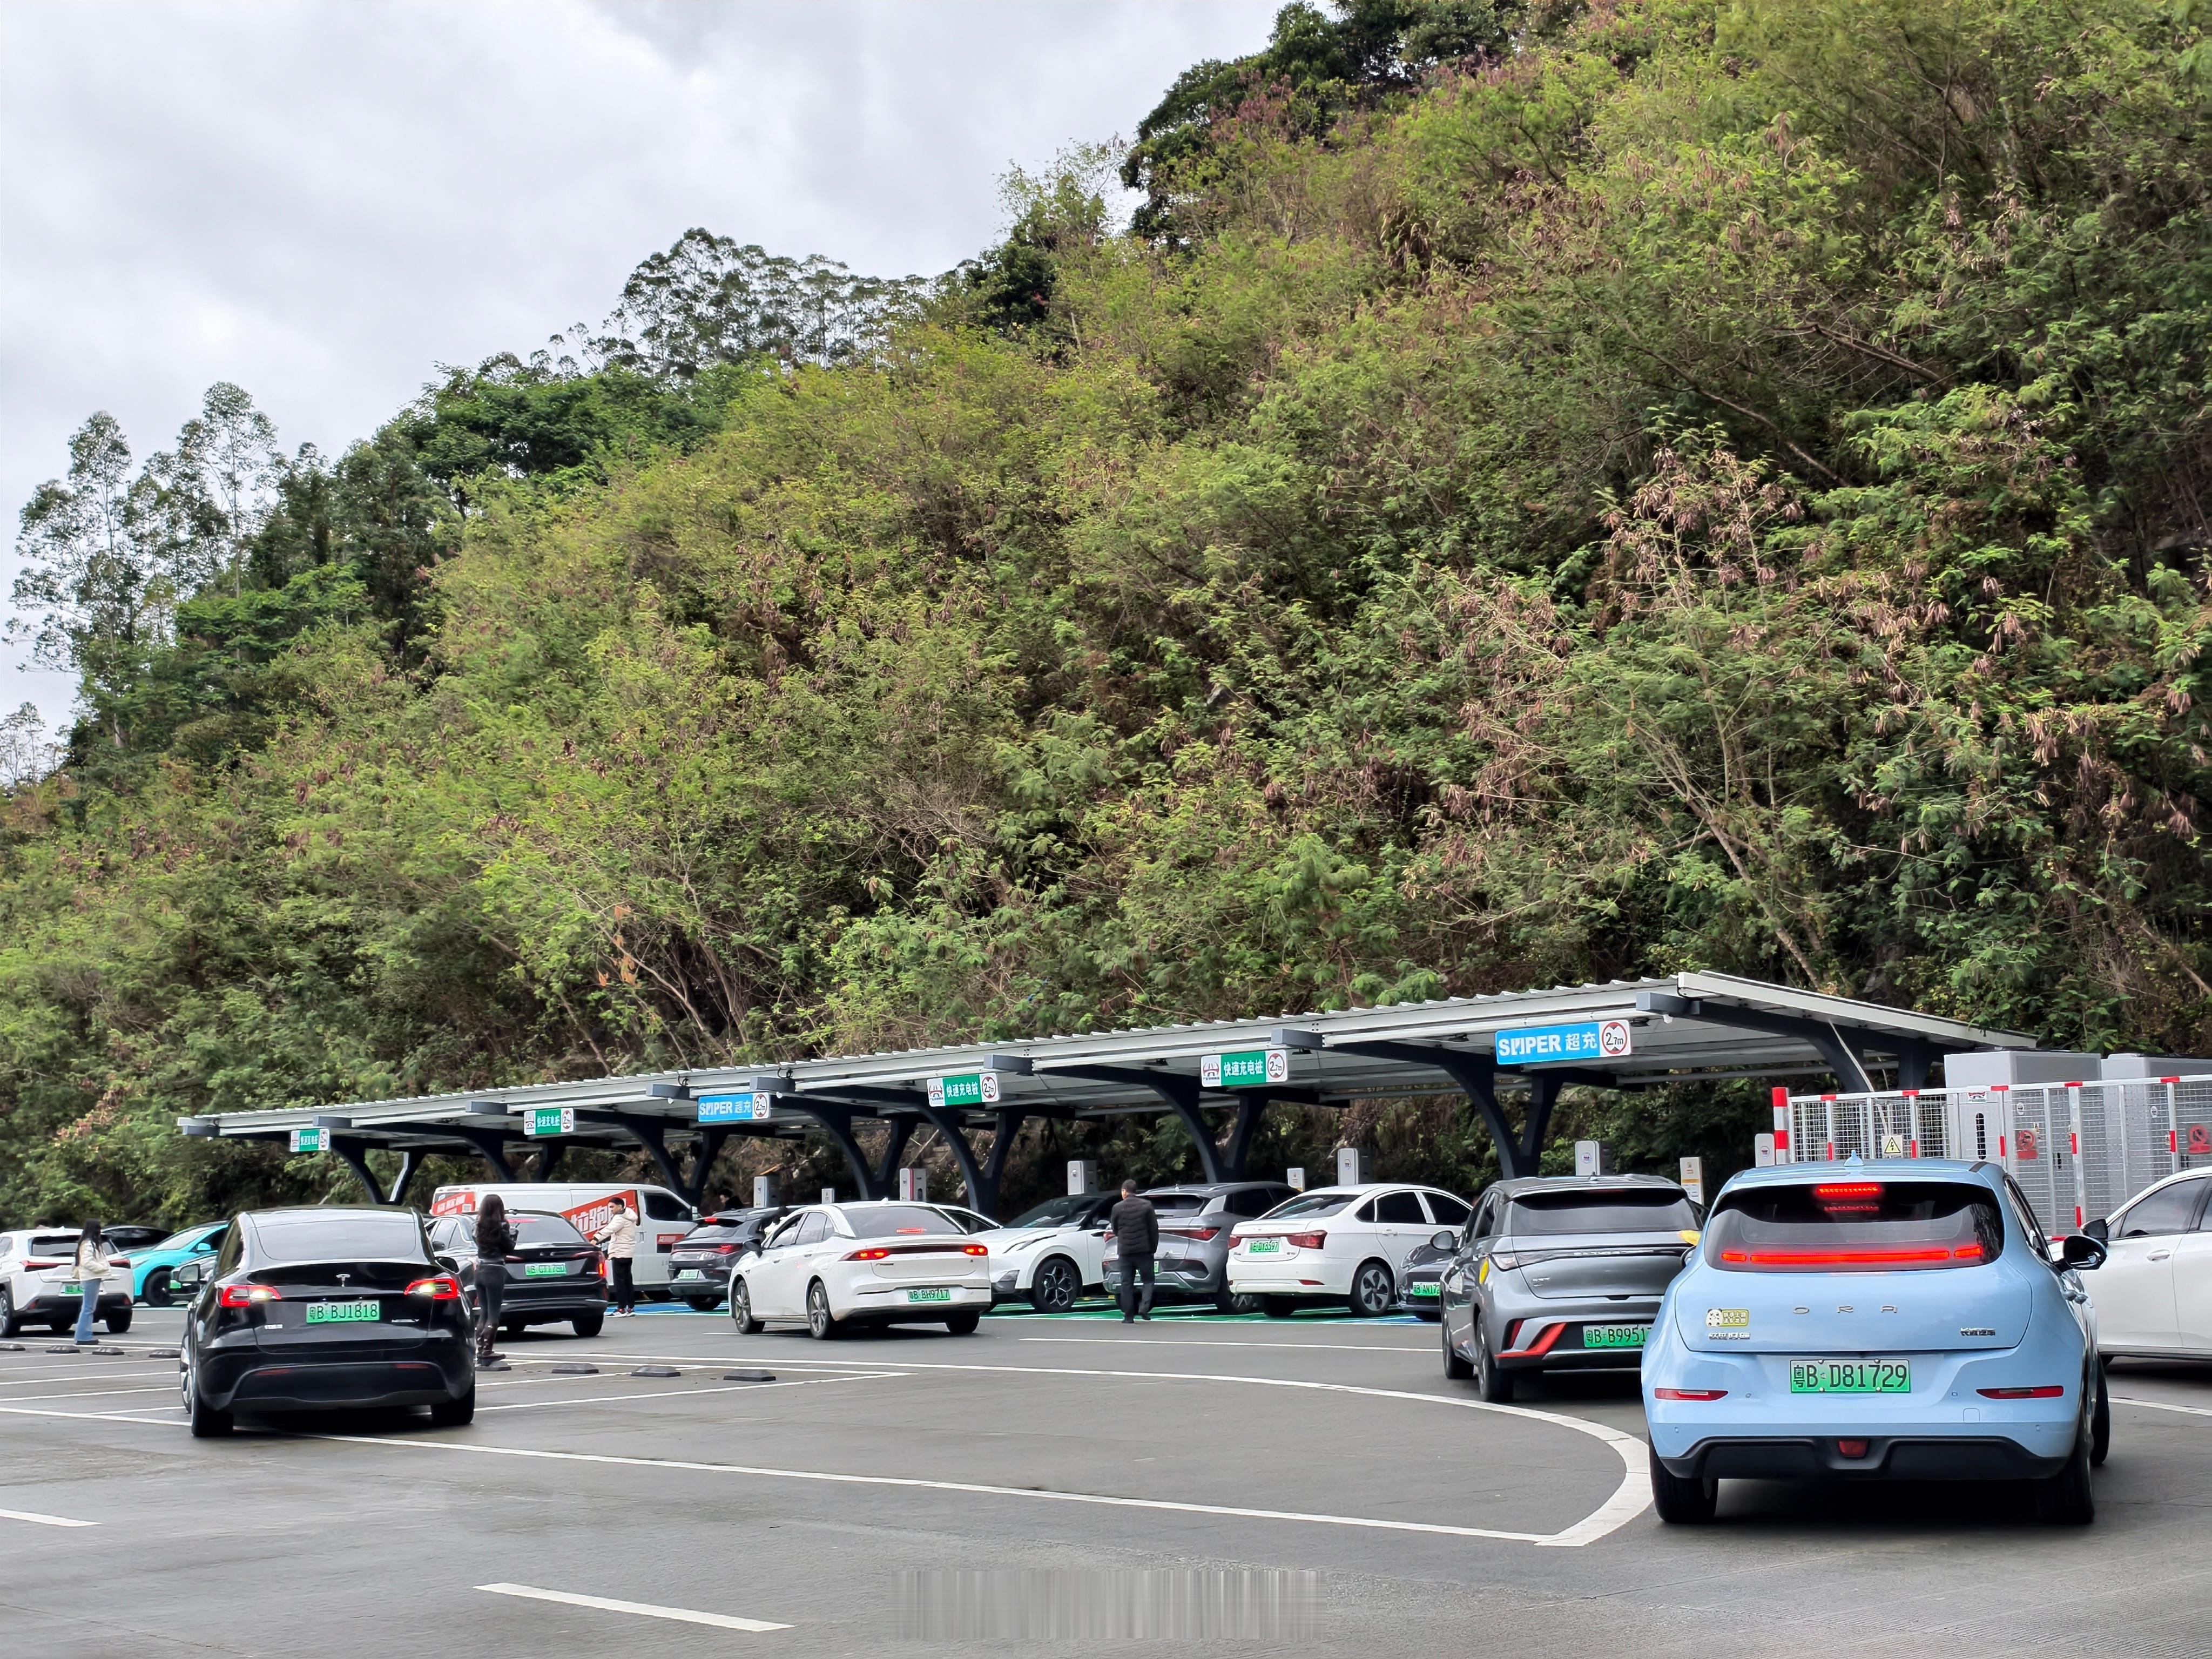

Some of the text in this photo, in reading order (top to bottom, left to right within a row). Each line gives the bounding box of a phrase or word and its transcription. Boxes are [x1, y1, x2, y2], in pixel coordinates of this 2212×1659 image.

[1499, 1032, 1597, 1056] SUPER 超充
[1224, 1059, 1264, 1076] 快速充电桩
[946, 1082, 979, 1097] 快速充电桩
[699, 1102, 733, 1115] SUPER
[1793, 1305, 1897, 1313] ORA
